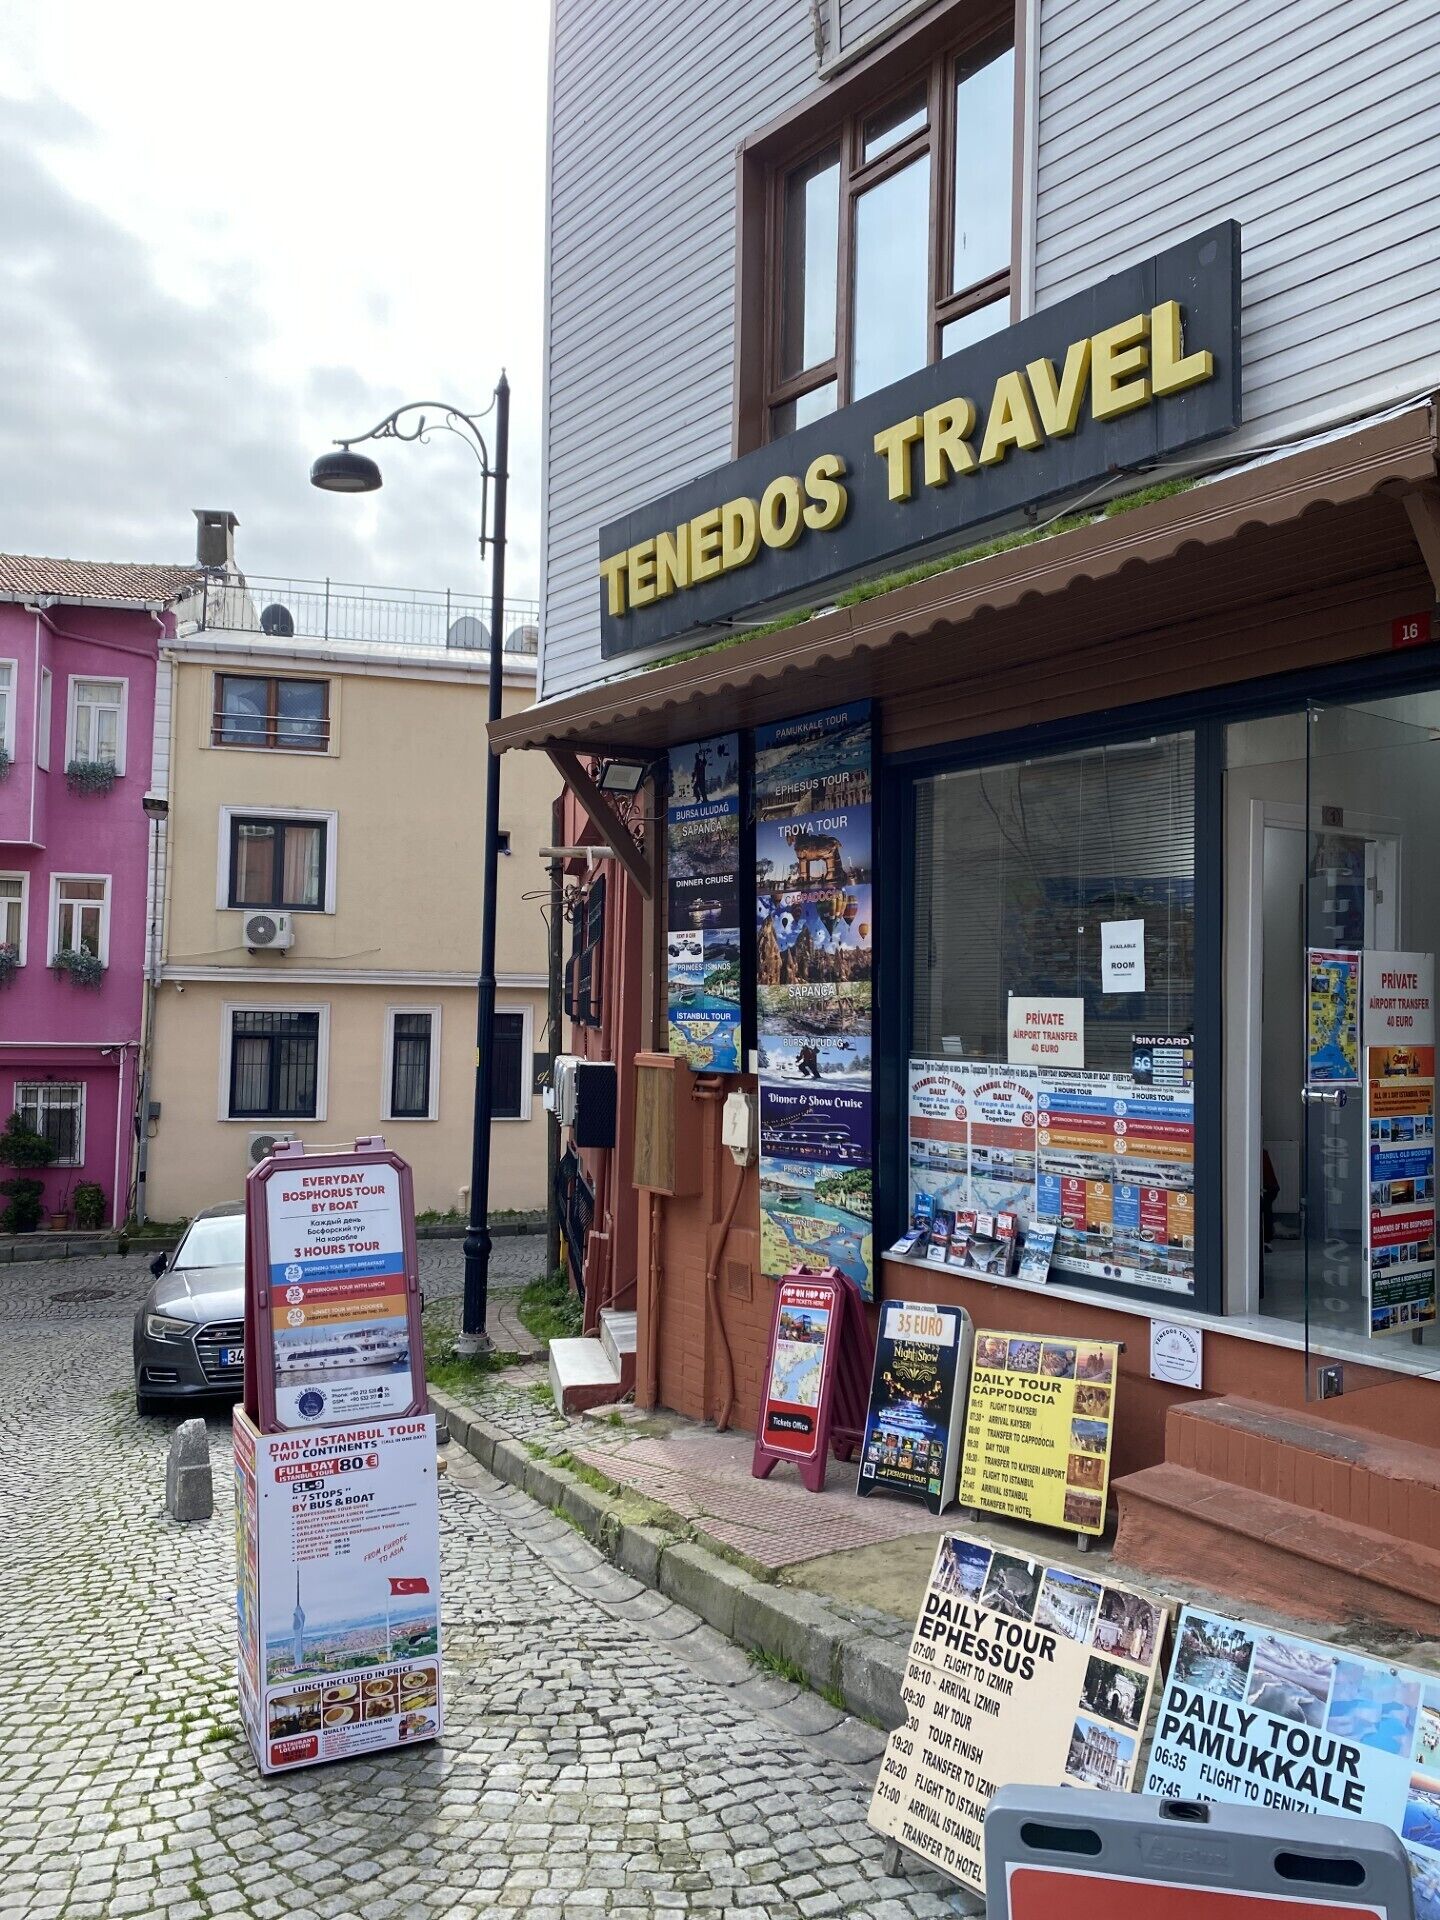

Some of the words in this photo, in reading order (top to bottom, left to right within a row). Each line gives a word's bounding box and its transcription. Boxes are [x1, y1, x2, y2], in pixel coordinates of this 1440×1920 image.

[600, 454, 847, 616] TENEDOS
[873, 299, 1213, 501] TRAVEL
[1402, 623, 1417, 639] 16
[775, 720, 822, 738] PAMUKKALE
[825, 712, 847, 725] TOUR
[775, 776, 818, 796] EPHESUS
[820, 771, 849, 787] TOUR
[676, 808, 698, 820] BURSA
[700, 802, 728, 816] ULUDAĞ
[777, 822, 813, 837] TROYA
[816, 815, 847, 831] TOUR
[676, 878, 703, 887] DINNER
[705, 875, 733, 884] CRUISE
[1111, 961, 1134, 969] ROOM
[1397, 998, 1429, 1009] TRANSFER
[711, 1011, 730, 1020] TOUR
[1386, 1015, 1394, 1027] 40
[1395, 1015, 1412, 1027] EURO
[783, 1038, 809, 1047] BURSA
[1043, 1031, 1077, 1041] TRANSFER
[1135, 1036, 1155, 1044] SIM
[1156, 1037, 1189, 1045] CARD
[1040, 1044, 1058, 1053] EURO
[1134, 1056, 1150, 1068] 5G
[767, 1092, 798, 1104] Dinner
[799, 1094, 807, 1104] &
[808, 1095, 833, 1106] Show
[834, 1097, 862, 1108] Cruise
[1136, 1092, 1156, 1100] HOURS
[302, 1173, 364, 1186] EVERYDAY
[282, 1188, 353, 1201] BOSPHORUS
[355, 1185, 385, 1195] TOUR
[311, 1203, 326, 1212] BY
[329, 1200, 358, 1210] BOAT
[310, 1217, 341, 1226] Каждый
[343, 1217, 361, 1225] день
[327, 1233, 357, 1242] корабле
[294, 1248, 301, 1257] 3
[304, 1242, 345, 1256] HOURS
[347, 1241, 379, 1252] TOUR
[783, 1287, 794, 1297] HOP
[795, 1289, 803, 1298] ON
[806, 1289, 818, 1298] HOP
[819, 1291, 832, 1300] OFF
[898, 1313, 911, 1332] 35
[914, 1314, 942, 1336] EURO
[1155, 1328, 1177, 1345] TENEDOS
[228, 1350, 244, 1363] 34
[893, 1345, 915, 1361] Night
[917, 1349, 938, 1362] Show
[973, 1371, 1014, 1386] DAILY
[1018, 1378, 1061, 1393] TOUR
[972, 1385, 1055, 1405] CAPPODOCIA
[989, 1401, 1006, 1412] FLIGHT
[1007, 1404, 1015, 1413] TO
[1016, 1404, 1037, 1416] KAYSERI
[773, 1415, 791, 1428] Tickets
[792, 1420, 808, 1431] Office
[988, 1414, 1009, 1426] ARRIVAL
[1010, 1418, 1031, 1429] KAYSERI
[268, 1438, 310, 1454] DAILY
[314, 1428, 383, 1445] ISTANBUL
[387, 1423, 425, 1436] TOUR
[987, 1428, 1012, 1441] TRANSFER
[1013, 1432, 1020, 1441] TO
[1021, 1434, 1054, 1447] CAPPODOCIA
[271, 1451, 299, 1462] TWO
[302, 1440, 377, 1457] CONTINENTS
[985, 1442, 995, 1451] DAY
[996, 1444, 1009, 1454] TOUR
[278, 1465, 308, 1475] FULL
[311, 1460, 334, 1473] DAY
[339, 1456, 363, 1471] 80
[984, 1455, 1010, 1467] TRANSFER
[1011, 1459, 1017, 1469] TO
[1018, 1461, 1040, 1474] KAYSERI
[1041, 1465, 1065, 1479] AIRPORT
[279, 1472, 313, 1482] ISTANBUL
[314, 1469, 334, 1477] TOUR
[982, 1469, 1000, 1481] FLIGHT
[1001, 1472, 1008, 1482] TO
[1008, 1474, 1033, 1487] ISTANBUL
[293, 1480, 322, 1492] SL-9
[309, 1488, 342, 1500] STOPS
[981, 1483, 1002, 1496] ARRIVAL
[1003, 1487, 1027, 1501] ISTANBUL
[292, 1503, 306, 1512] BY
[309, 1499, 332, 1509] BUS
[334, 1496, 344, 1505] &
[345, 1493, 375, 1504] BOAT
[980, 1497, 1006, 1510] TRANSFER
[1007, 1502, 1013, 1511] TO
[1014, 1503, 1031, 1517] HOTEL
[363, 1547, 380, 1561] FROM
[383, 1533, 407, 1551] EUROPE
[379, 1554, 387, 1563] TO
[389, 1545, 404, 1558] ASIA
[925, 1592, 988, 1633] DAILY
[994, 1618, 1056, 1661] TOUR
[918, 1616, 1035, 1680] EPHESSUS
[912, 1641, 935, 1661] 07:00
[943, 1653, 972, 1677] FLIGHT
[973, 1665, 984, 1682] TO
[986, 1671, 1014, 1696] IZMIR
[292, 1681, 324, 1693] LUNCH
[326, 1672, 373, 1686] INCLUDED
[374, 1669, 384, 1678] IN
[387, 1664, 413, 1675] PRICE
[908, 1664, 931, 1685] 08:10
[938, 1678, 970, 1704] ARRIVAL
[973, 1692, 1000, 1716] IZMIR
[902, 1687, 925, 1708] 09:30
[932, 1700, 949, 1719] DAY
[950, 1707, 972, 1730] TOUR
[1166, 1685, 1258, 1738] DAILY
[1268, 1719, 1360, 1778] TOUR
[928, 1725, 951, 1748] TOUR
[952, 1737, 983, 1764] FINISH
[891, 1734, 913, 1756] 19:20
[921, 1748, 962, 1781] TRANSFER
[964, 1769, 975, 1787] TO
[1160, 1713, 1365, 1814] PAMUKKALE
[884, 1757, 907, 1780] 20:20
[914, 1773, 943, 1799] FLIGHT
[945, 1788, 955, 1806] TO
[1154, 1746, 1187, 1771] 06:35
[1199, 1763, 1242, 1794] FLIGHT
[1244, 1780, 1259, 1800] TO
[1149, 1773, 1181, 1797] 07:45
[877, 1780, 900, 1804] 21:00
[907, 1798, 941, 1826] ARRIVAL
[941, 1818, 981, 1850] ISTANBUL
[900, 1822, 941, 1856] TRANSFER
[943, 1846, 954, 1865] TO
[955, 1855, 983, 1882] HOTEL
